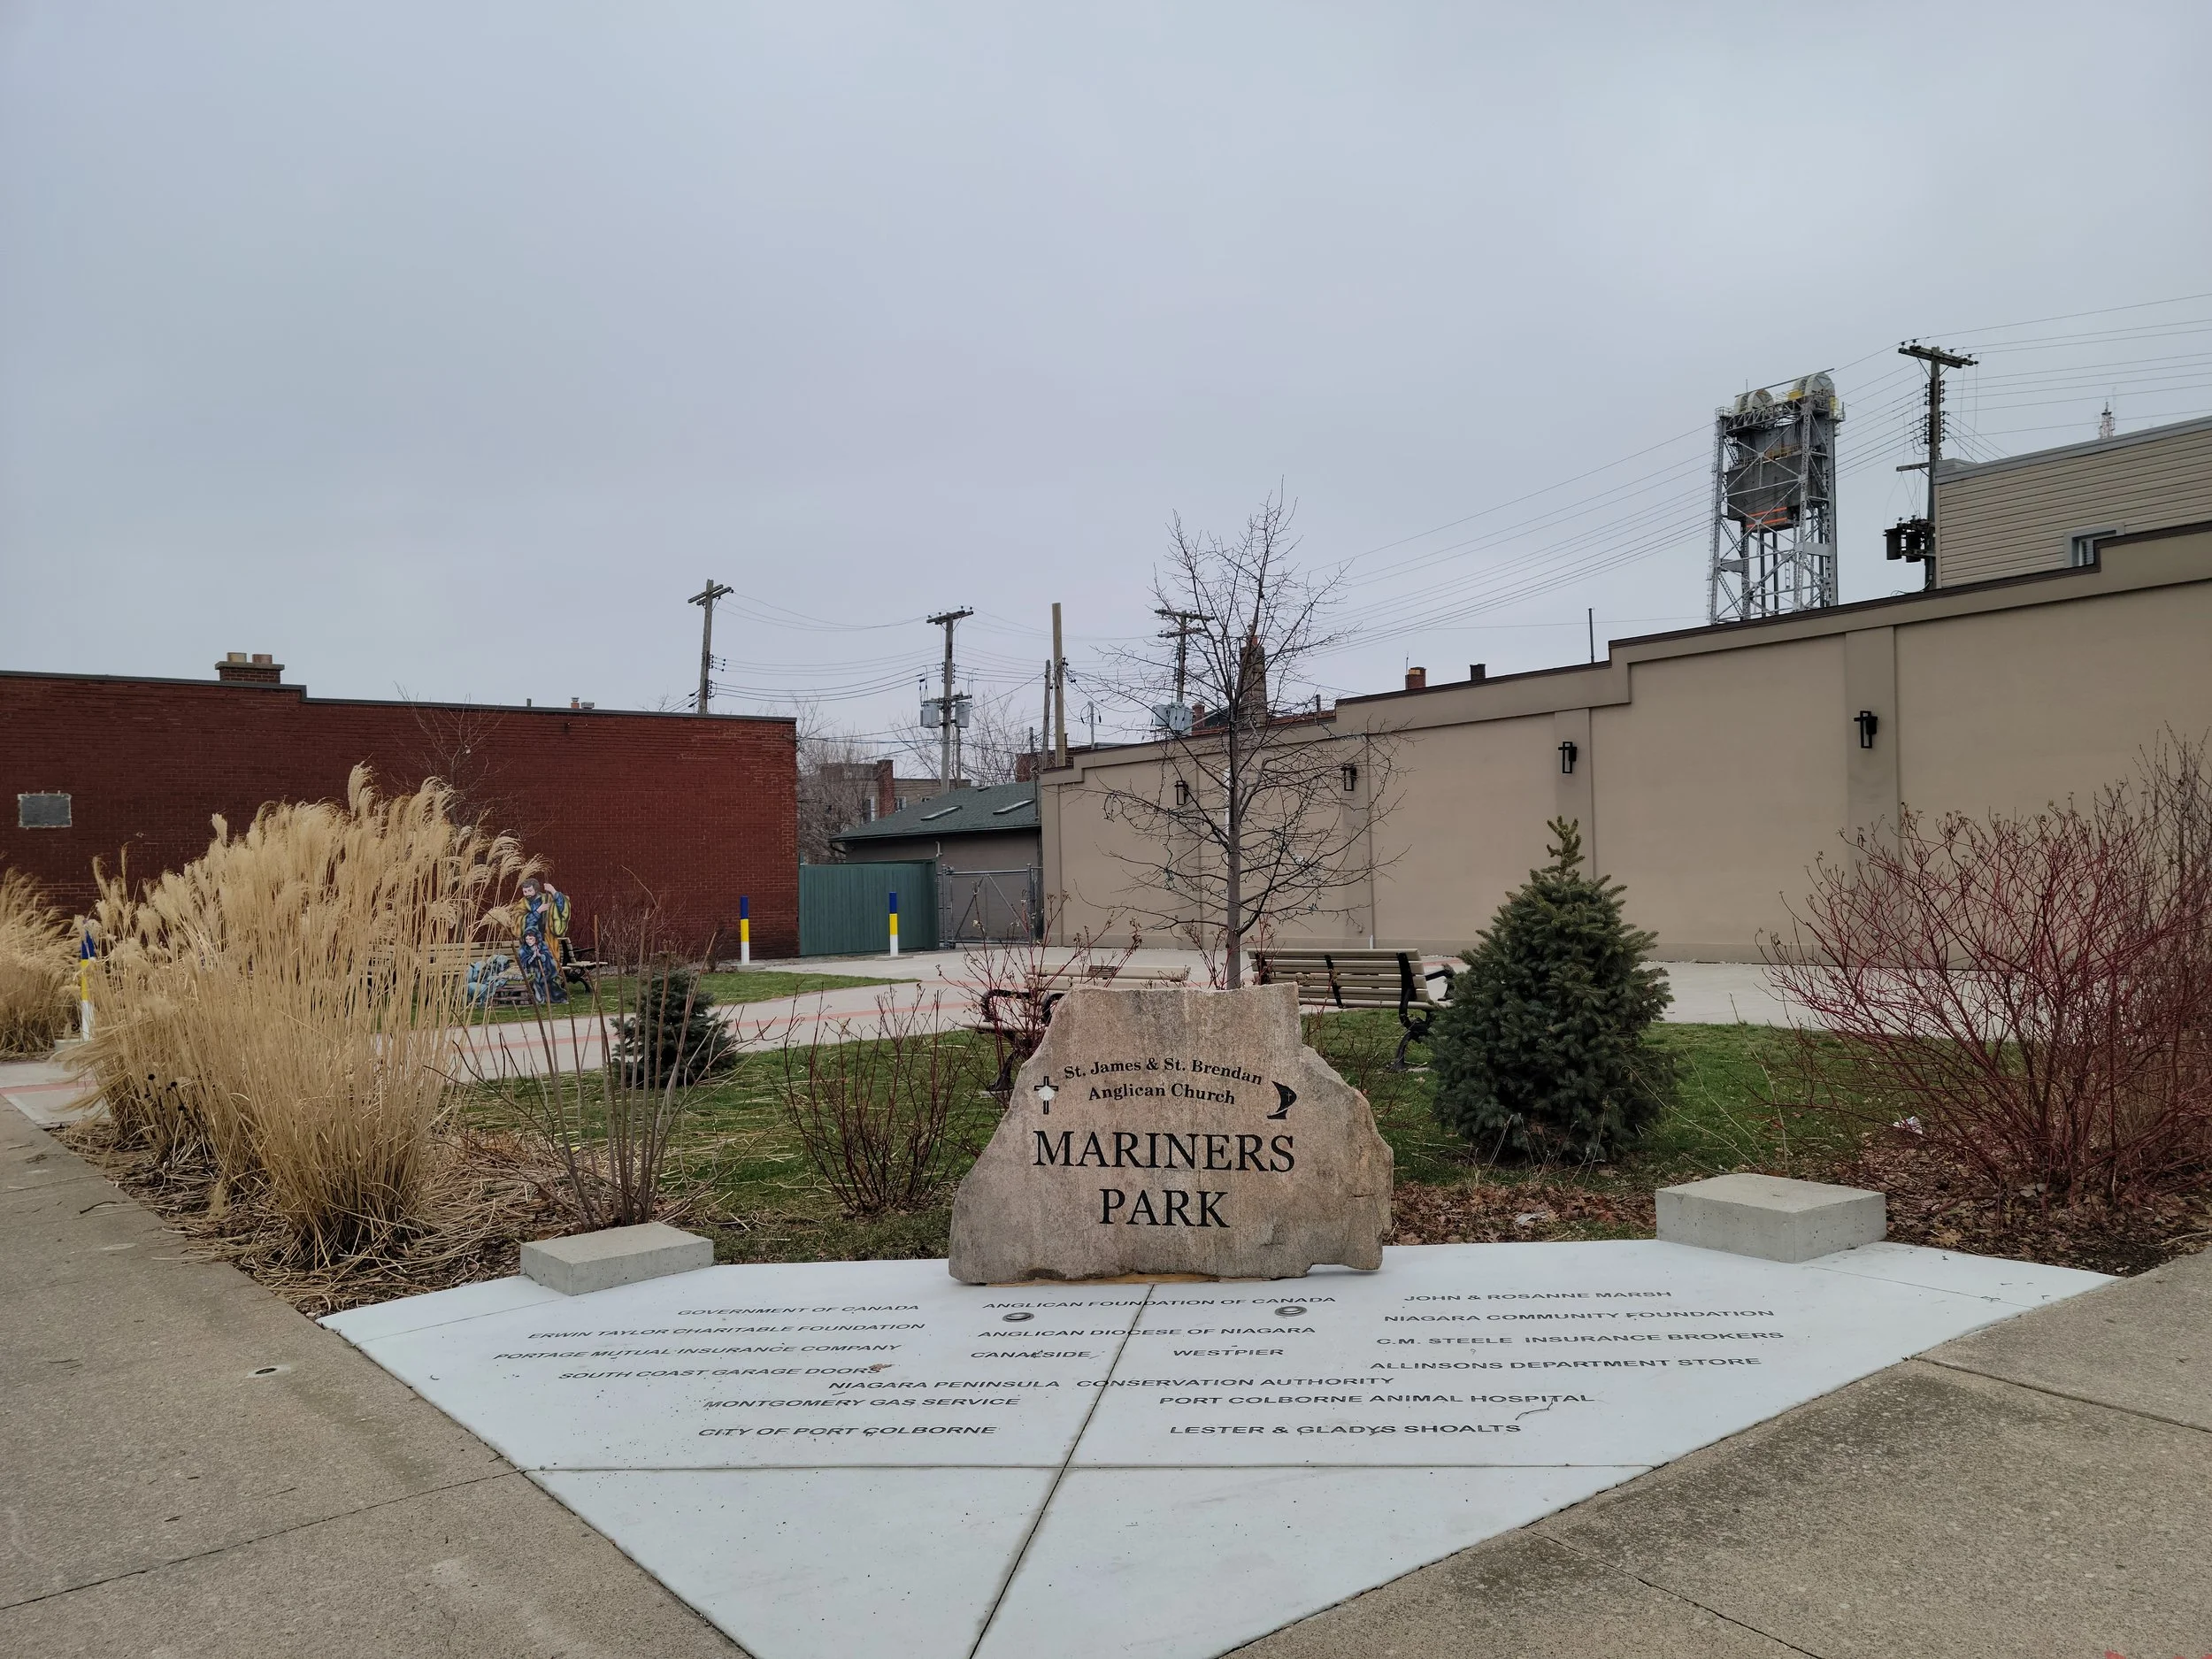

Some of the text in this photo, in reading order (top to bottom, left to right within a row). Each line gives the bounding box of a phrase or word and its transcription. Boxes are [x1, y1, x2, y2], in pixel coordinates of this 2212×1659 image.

[1064, 1058, 1262, 1085] St. James & St. Brendan
[1088, 1083, 1235, 1104] Anglican Church
[1033, 1131, 1295, 1172] MARINERS
[1099, 1188, 1230, 1227] PARK
[1487, 1292, 1591, 1301] ROSANNE
[677, 1307, 808, 1317] GOVERNMENT
[841, 1304, 920, 1313] CANADA
[1383, 1310, 1775, 1323] NIAGARA COMMUNITY FOUNDATION
[526, 1323, 926, 1340] ERWIN TAYLOR CHARITABLE FOUNDATION
[977, 1329, 1086, 1338] ANGLICAN
[1220, 1326, 1316, 1335] NIAGARA
[1428, 1336, 1513, 1345] STEELE
[1524, 1334, 1663, 1344] INSURANCE
[1666, 1331, 1785, 1341] BROKERS
[493, 1343, 903, 1360] PORTAGE MUTUAL INSURANCE COMPANY
[970, 1350, 1091, 1359] CANALSIDE
[1172, 1348, 1285, 1357] WESTPIER
[1370, 1356, 1763, 1371] ALLINSONS DEPARTMENT STORE
[558, 1366, 880, 1380] SOUTH COAST GARAGE DOORS
[827, 1376, 1394, 1390] NIAGARA PENINSULA CONSERVATION AUTHORITY
[703, 1397, 1022, 1409] MONTGOMERY GAS SERVICE
[1158, 1394, 1596, 1405] PORT COLBORNE ANIMAL HOSPITAL
[697, 1425, 997, 1438] CITY OF PORT COLBORNE
[1169, 1424, 1522, 1435] LESTER & GLADYS SHOALTS
